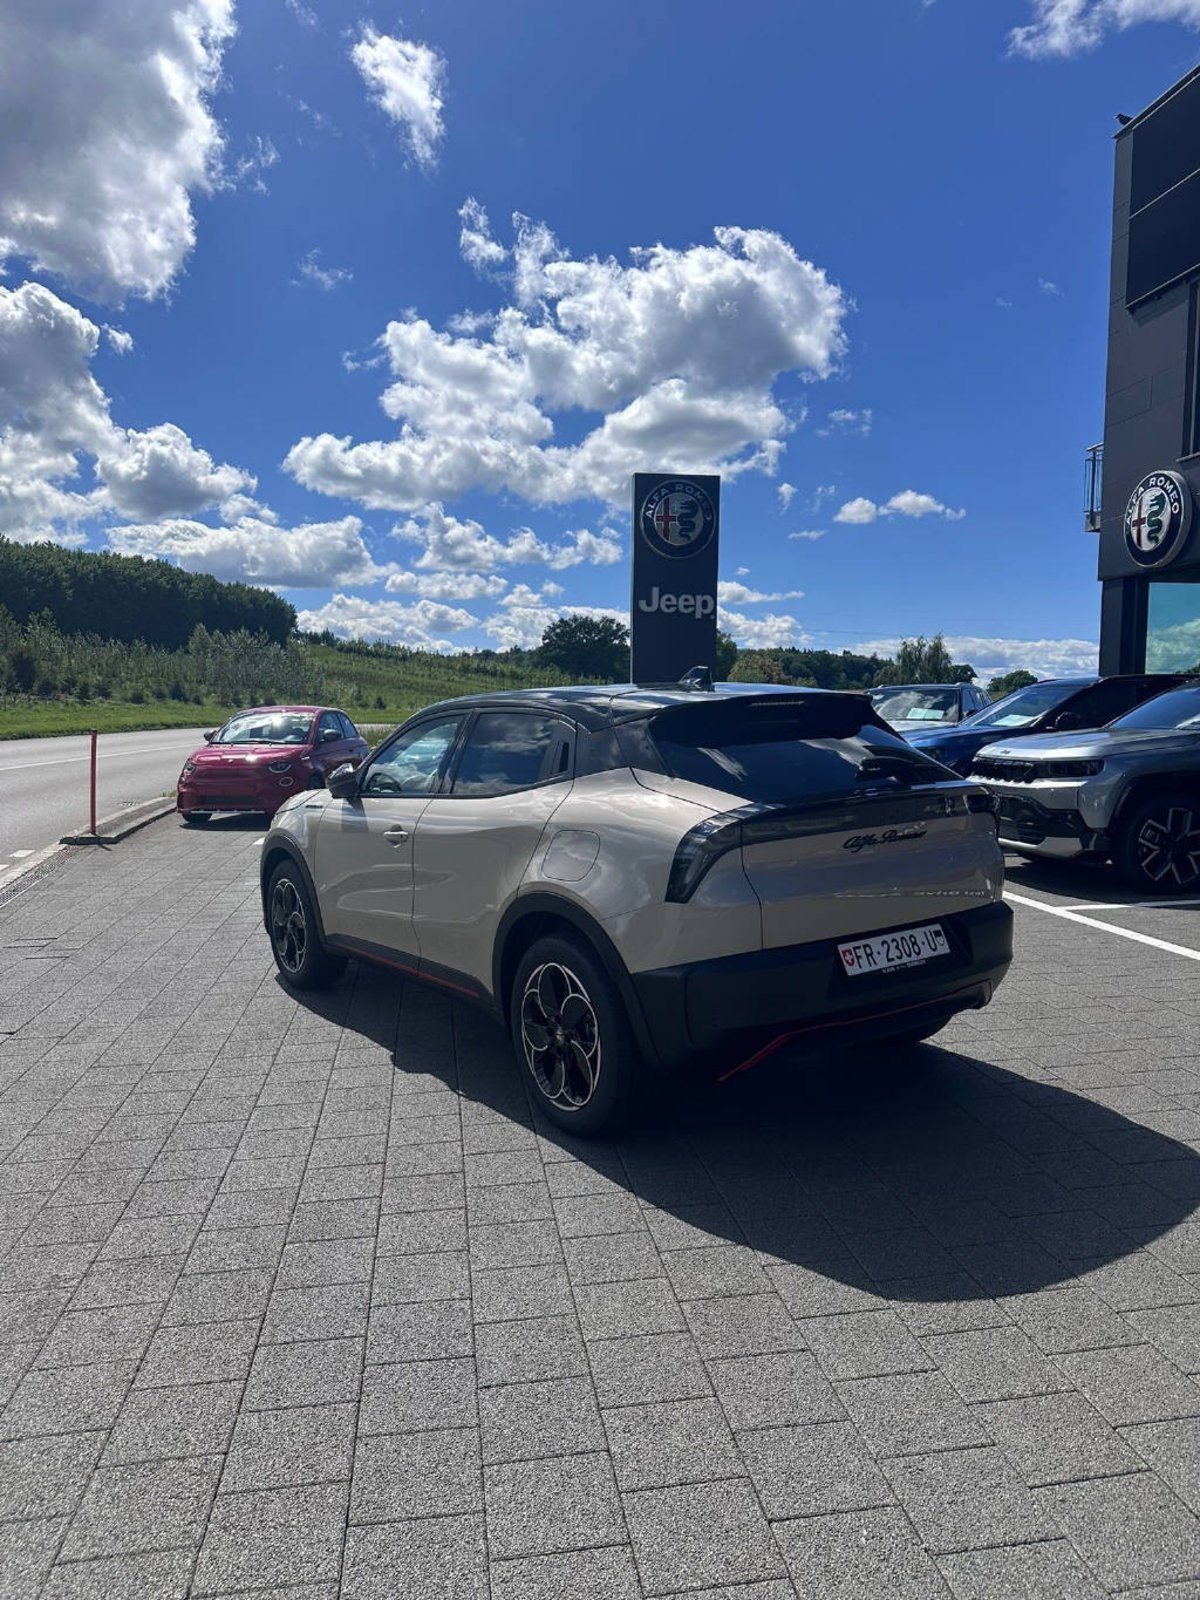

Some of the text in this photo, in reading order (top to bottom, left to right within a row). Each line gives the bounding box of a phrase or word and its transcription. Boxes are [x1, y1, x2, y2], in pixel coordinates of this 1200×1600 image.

[645, 483, 713, 521] ALFA ROMEO
[1126, 476, 1180, 525] ALFA ROMEO
[638, 586, 715, 619] Jeep
